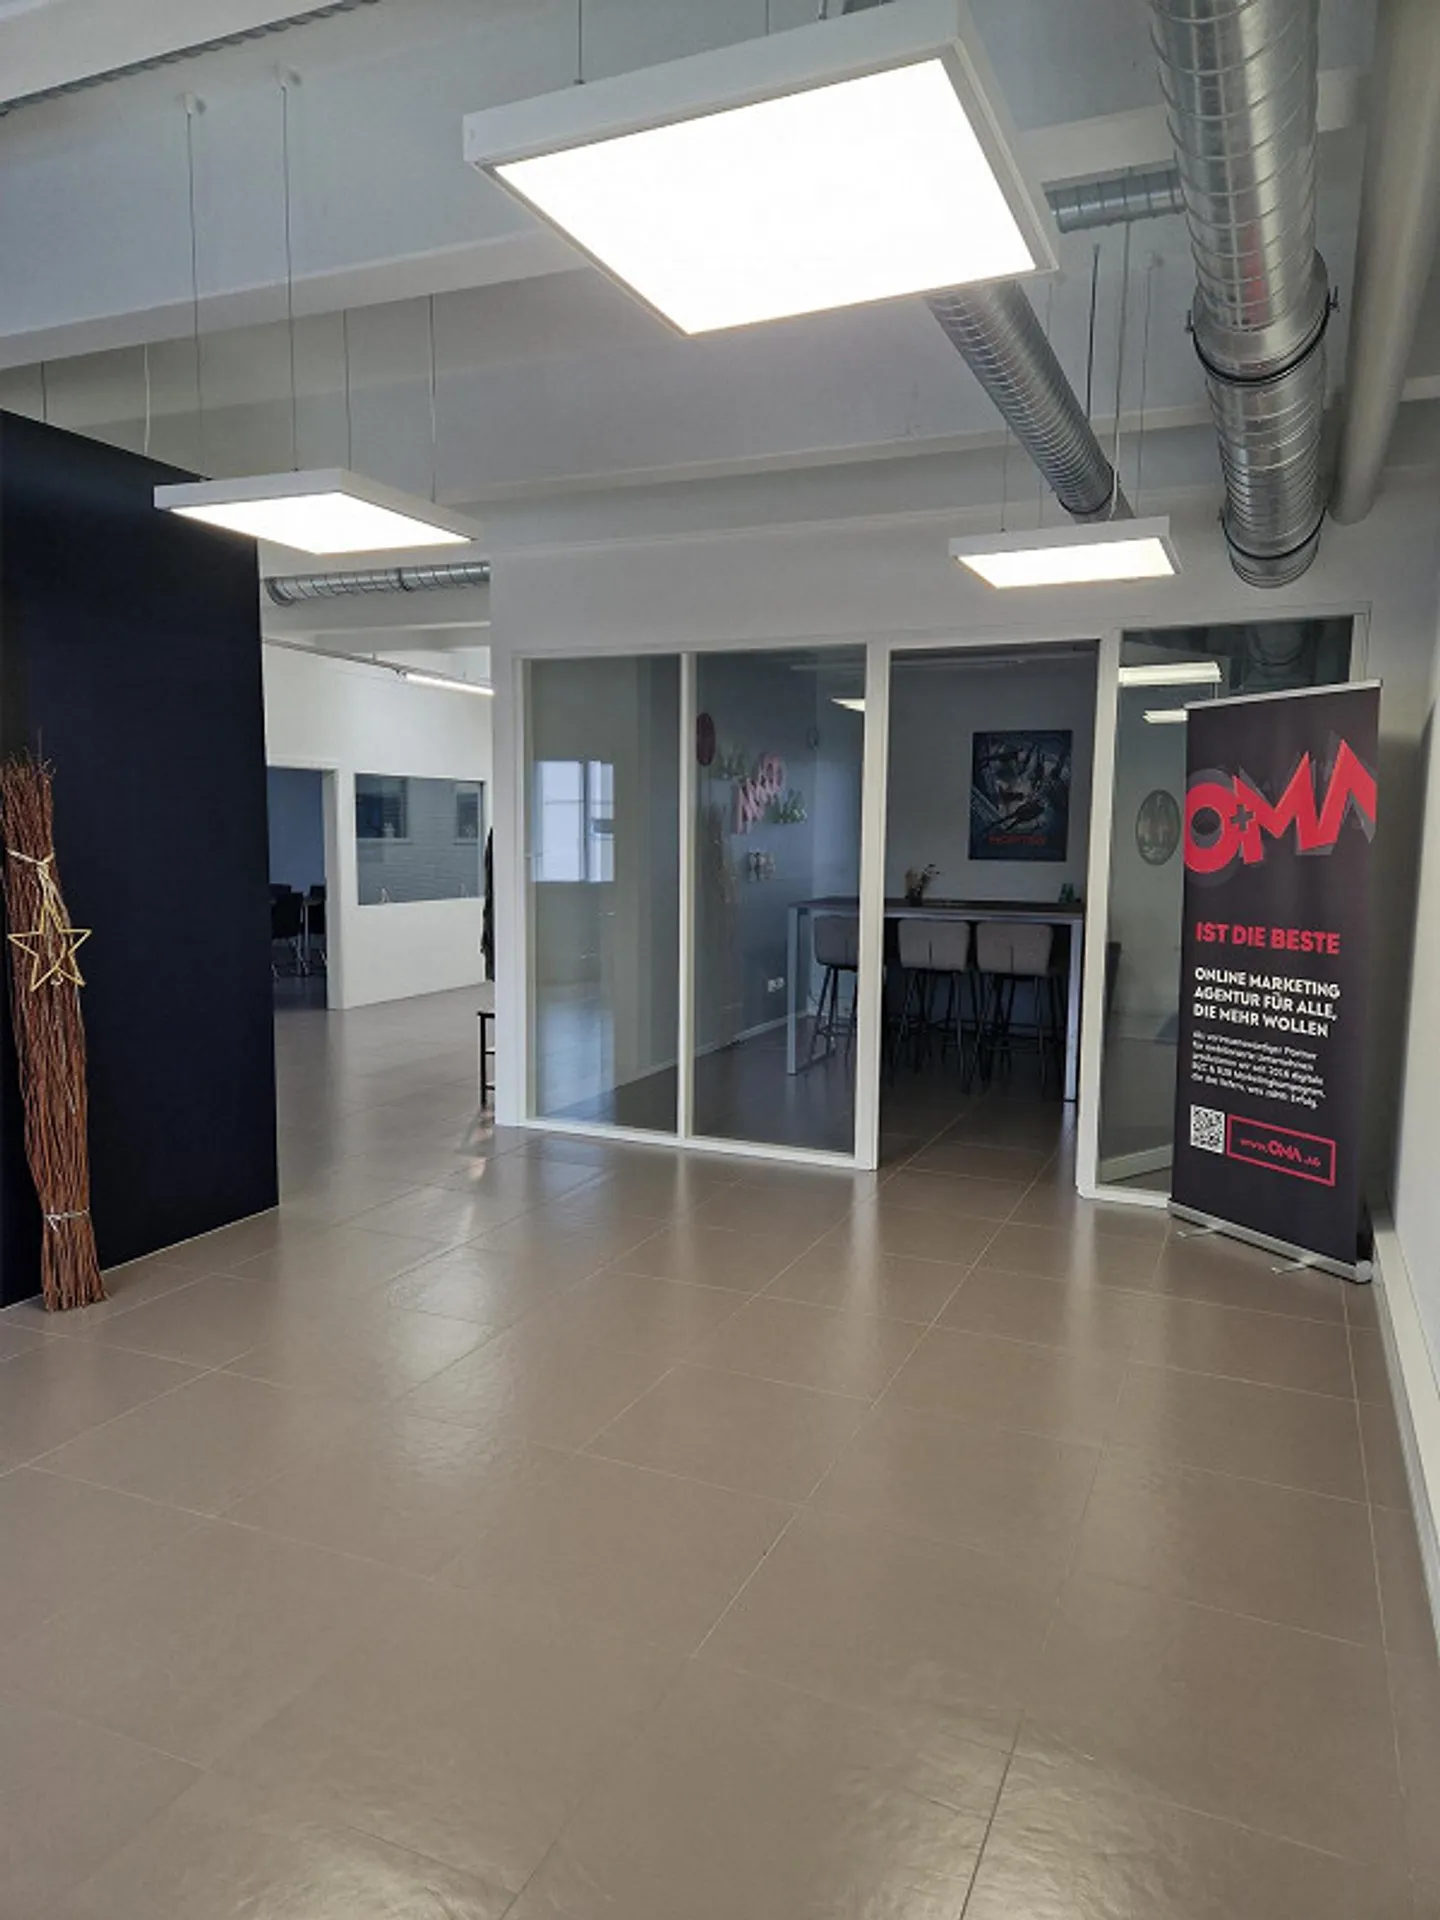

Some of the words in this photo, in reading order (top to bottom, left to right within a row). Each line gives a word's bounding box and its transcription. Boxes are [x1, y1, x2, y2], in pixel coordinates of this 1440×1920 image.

[1195, 921, 1230, 945] IST
[1232, 924, 1265, 947] DIE
[1270, 928, 1341, 955] BESTE
[1194, 967, 1247, 985] ONLINE
[1248, 973, 1341, 999] MARKETING
[1193, 986, 1261, 1007] AGENTUR
[1263, 991, 1293, 1012] FÜR
[1296, 1000, 1338, 1021] ALLE,
[1193, 1003, 1217, 1019] DIE
[1219, 1007, 1260, 1026] MEHR
[1262, 1014, 1329, 1038] WOLLEN
